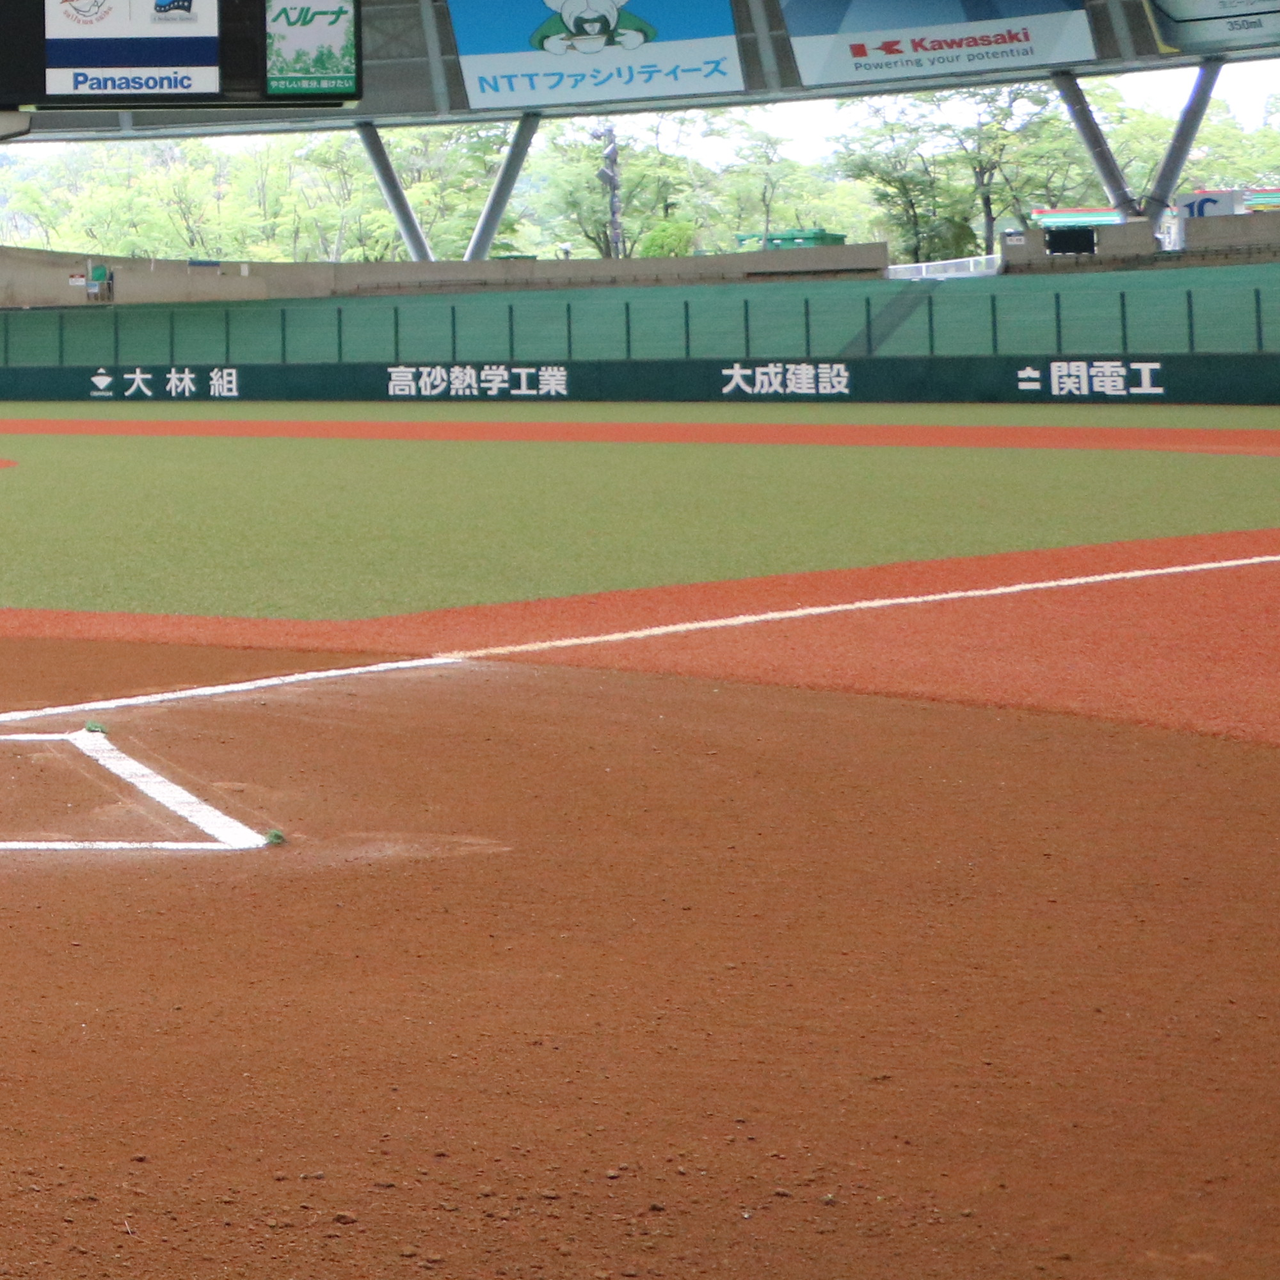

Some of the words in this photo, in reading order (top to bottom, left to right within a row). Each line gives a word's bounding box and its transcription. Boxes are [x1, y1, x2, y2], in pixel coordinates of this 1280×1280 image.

[271, 6, 349, 27] ベルーナ
[1227, 19, 1263, 31] 350ml
[910, 27, 1030, 53] Kawasaki
[854, 58, 922, 71] Powering
[927, 55, 961, 66] your
[967, 47, 1034, 63] potential
[72, 71, 192, 90] Panasonic
[477, 56, 728, 94] NTTファシリティーズ
[123, 368, 238, 397] 大林組
[387, 365, 568, 396] 高砂熱学工業
[721, 363, 850, 395] 大成建設
[1050, 361, 1164, 396] 関電工
